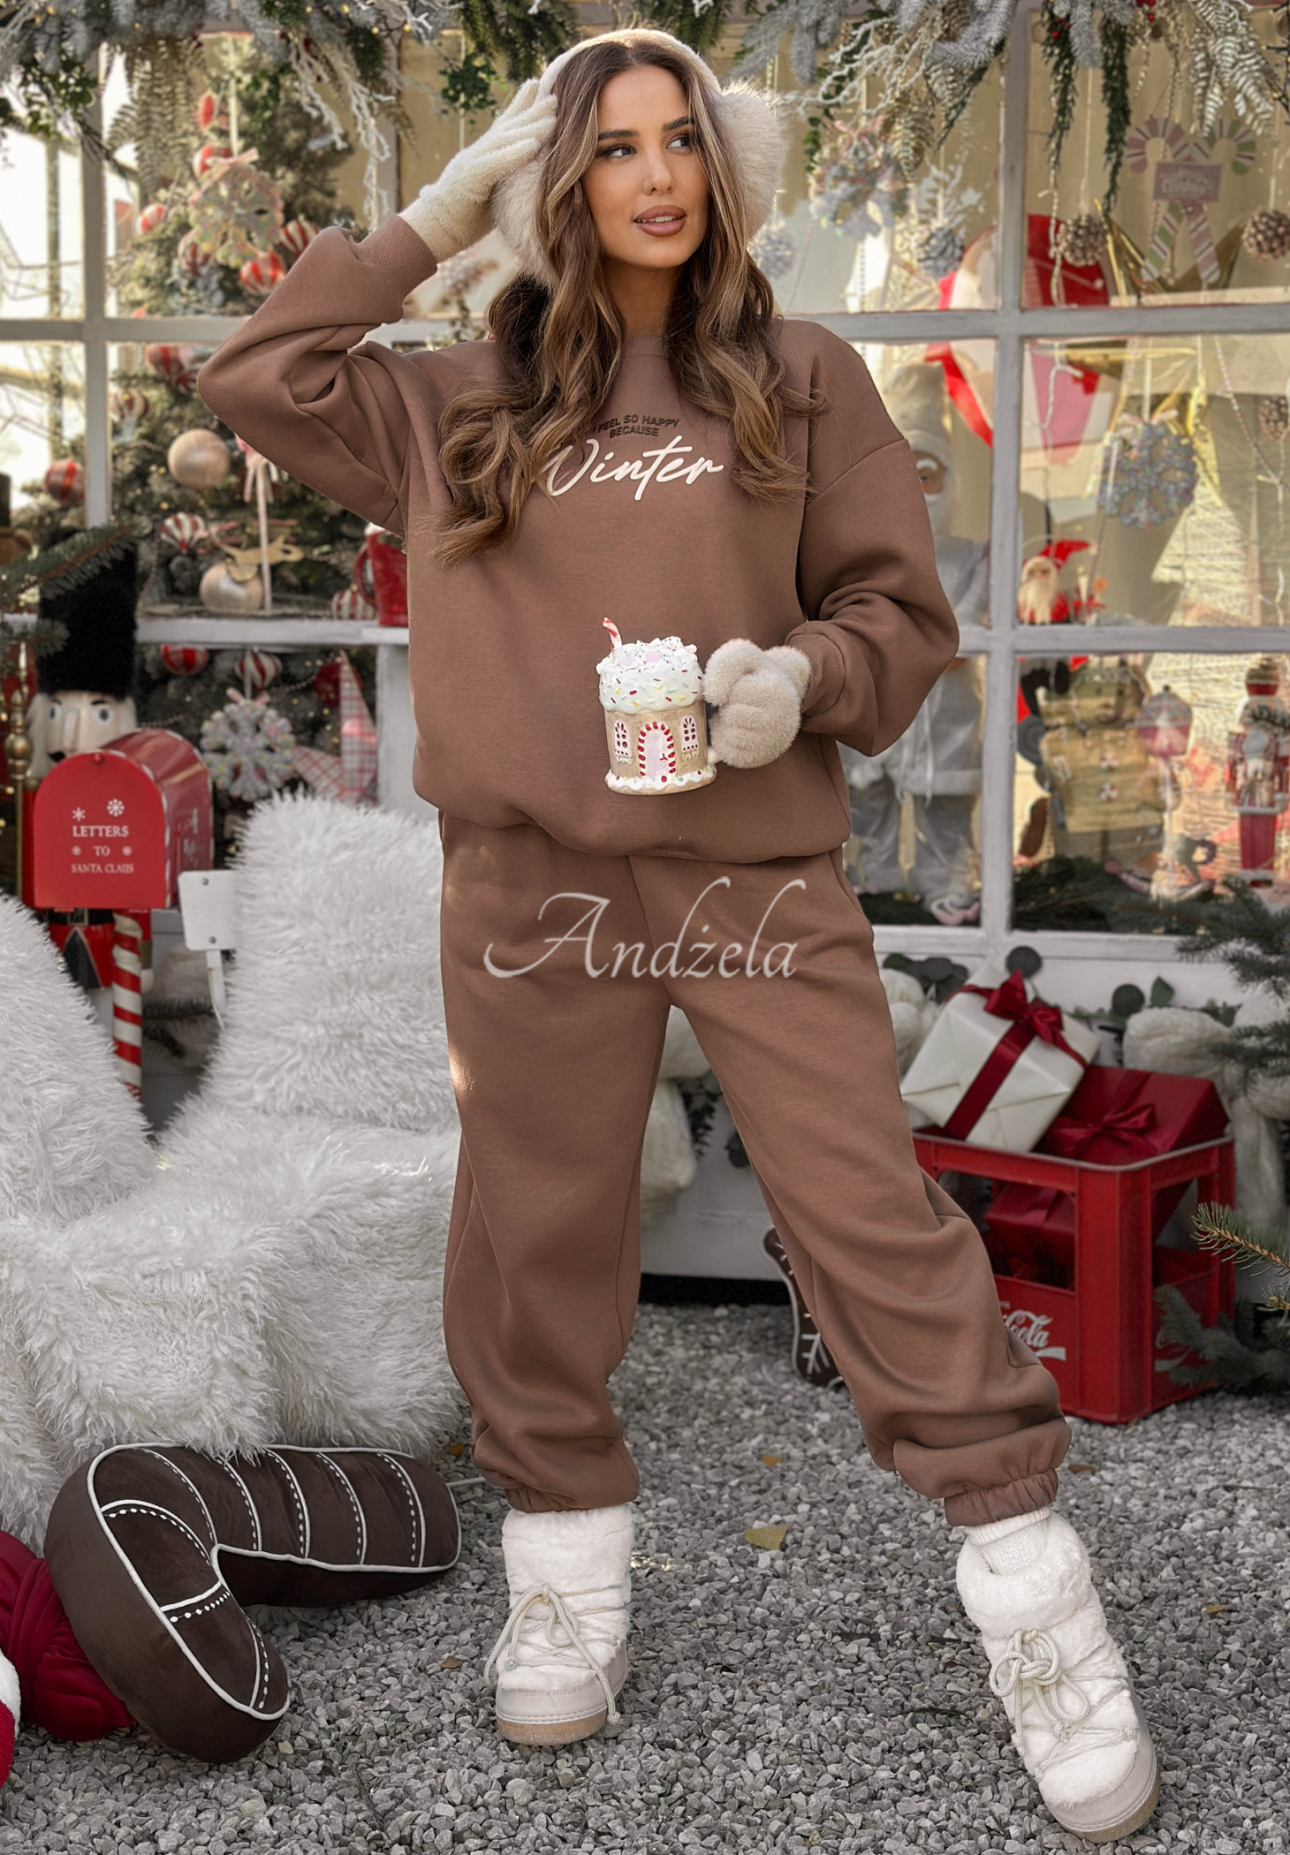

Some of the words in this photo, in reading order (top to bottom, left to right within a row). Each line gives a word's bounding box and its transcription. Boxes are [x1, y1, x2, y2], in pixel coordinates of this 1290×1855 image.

[598, 417, 621, 433] FEEL
[623, 414, 639, 424] SO
[642, 415, 680, 428] HAPPY
[609, 425, 660, 439] BECAUSE
[541, 435, 724, 501] Winter
[72, 825, 130, 838] LETTERS
[93, 845, 111, 857] TO
[71, 863, 103, 874] SANTA
[104, 863, 135, 874] CLAUS
